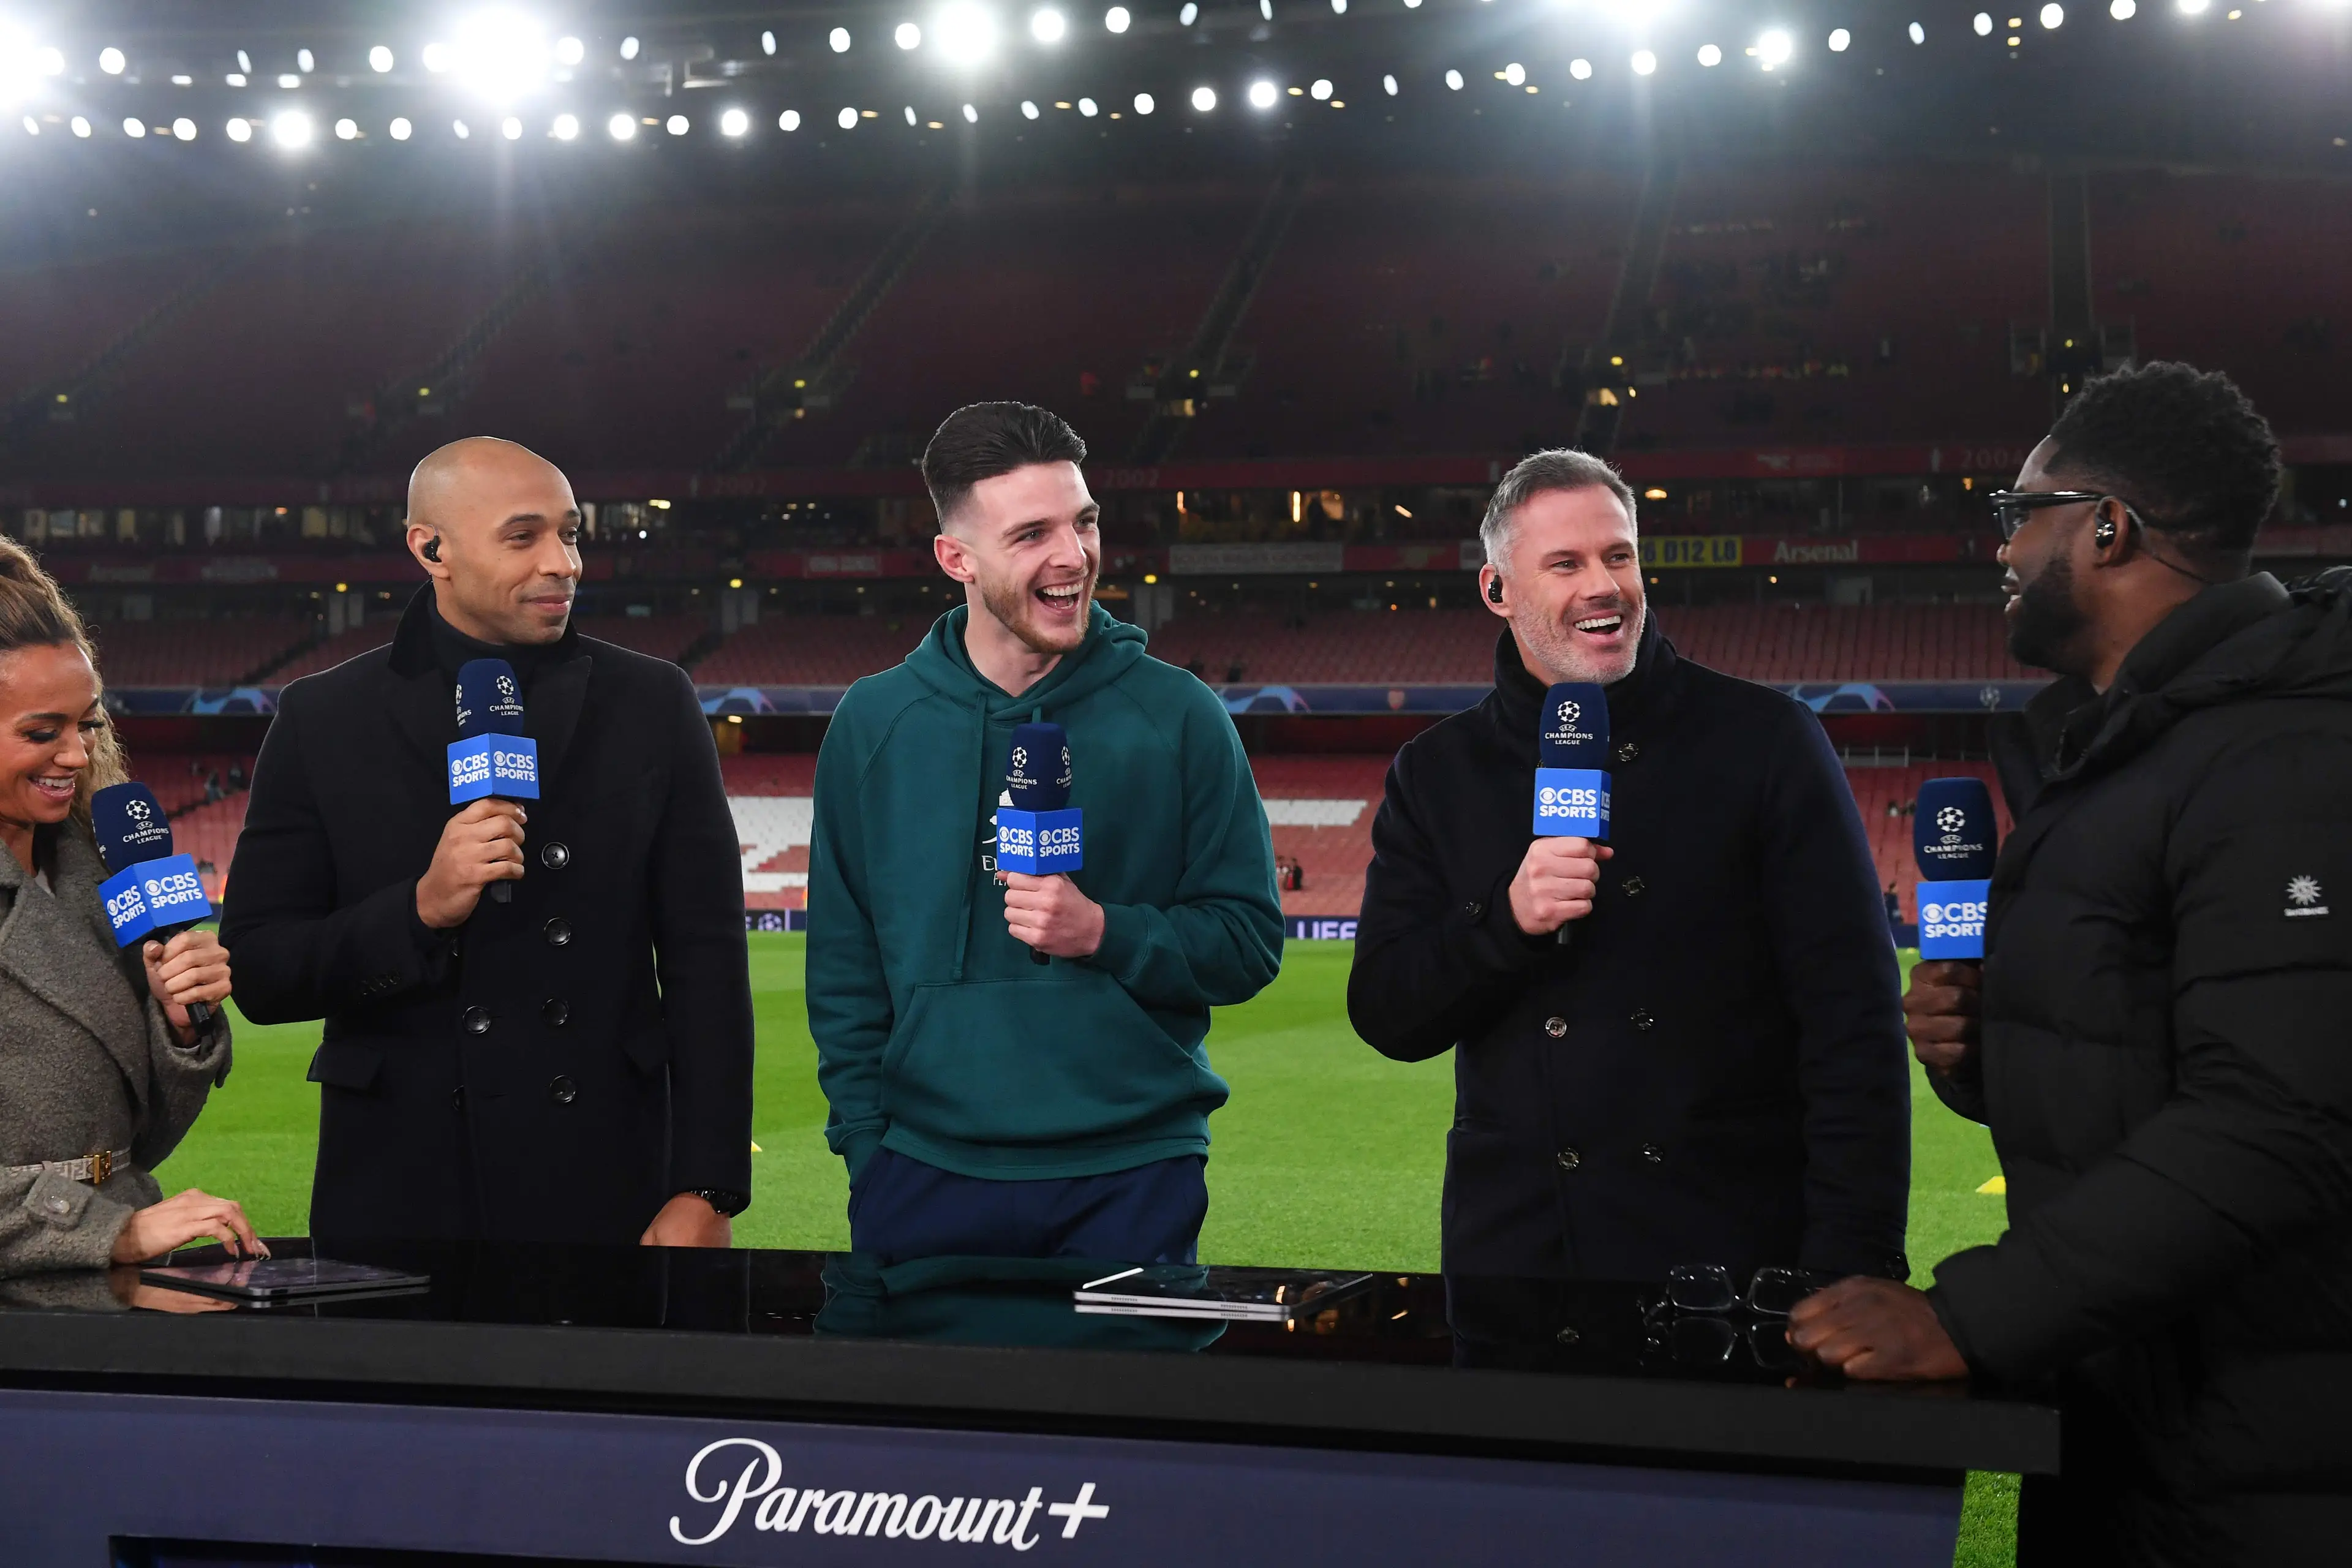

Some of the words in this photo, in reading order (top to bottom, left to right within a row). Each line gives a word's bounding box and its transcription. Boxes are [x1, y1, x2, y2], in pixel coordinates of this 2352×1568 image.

[1773, 540, 1859, 563] Arsenal
[1558, 723, 1578, 733] UEFA
[462, 752, 489, 772] CBS
[506, 753, 535, 770] CBS
[452, 767, 490, 787] SPORTS
[494, 767, 536, 782] SPORTS
[1006, 775, 1038, 785] CHAMPIONS
[1556, 788, 1597, 805] CBS
[1539, 805, 1597, 818] SPORTS
[123, 827, 169, 842] CHAMPIONS
[137, 835, 164, 844] LEAGUE
[1009, 828, 1033, 845] CBS
[1051, 827, 1080, 844] CBS
[1000, 842, 1034, 857] SPORTS
[1039, 843, 1080, 858] SPORTS
[1924, 843, 1984, 853] CHAMPIONS
[160, 872, 198, 892] CBS
[116, 885, 141, 910] CBS
[151, 888, 203, 908] SPORTS
[113, 902, 146, 929] SPORTS
[1924, 922, 1985, 938] SPORT
[669, 1437, 1110, 1552] Paramount+
